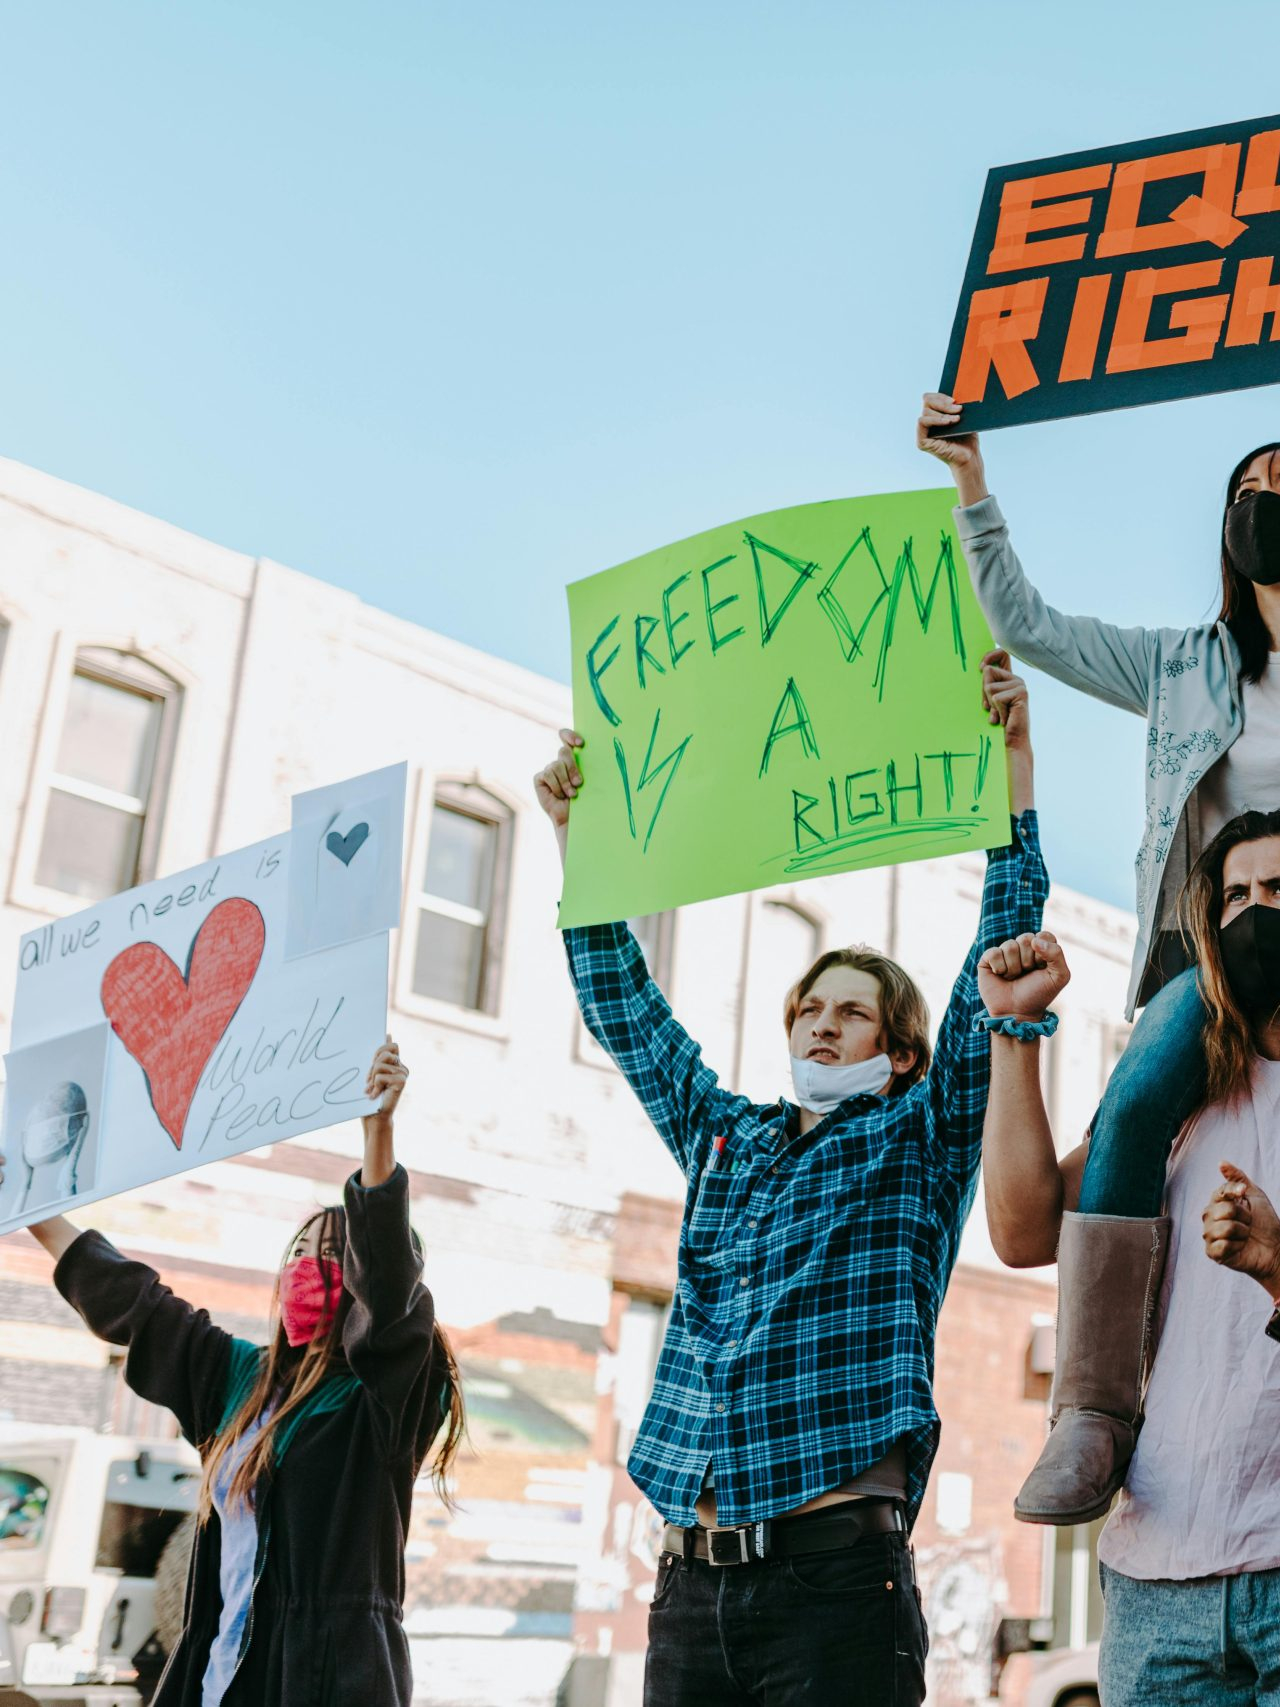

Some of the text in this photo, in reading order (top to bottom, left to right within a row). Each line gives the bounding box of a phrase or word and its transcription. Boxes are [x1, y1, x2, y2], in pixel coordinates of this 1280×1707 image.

[586, 526, 967, 727] FREEDOM
[758, 677, 820, 779] A
[792, 735, 992, 854] RIGHT!
[61, 920, 101, 957] we
[129, 865, 221, 931] need
[255, 850, 281, 880] is
[201, 996, 348, 1091] World
[198, 1067, 368, 1152] Peace
